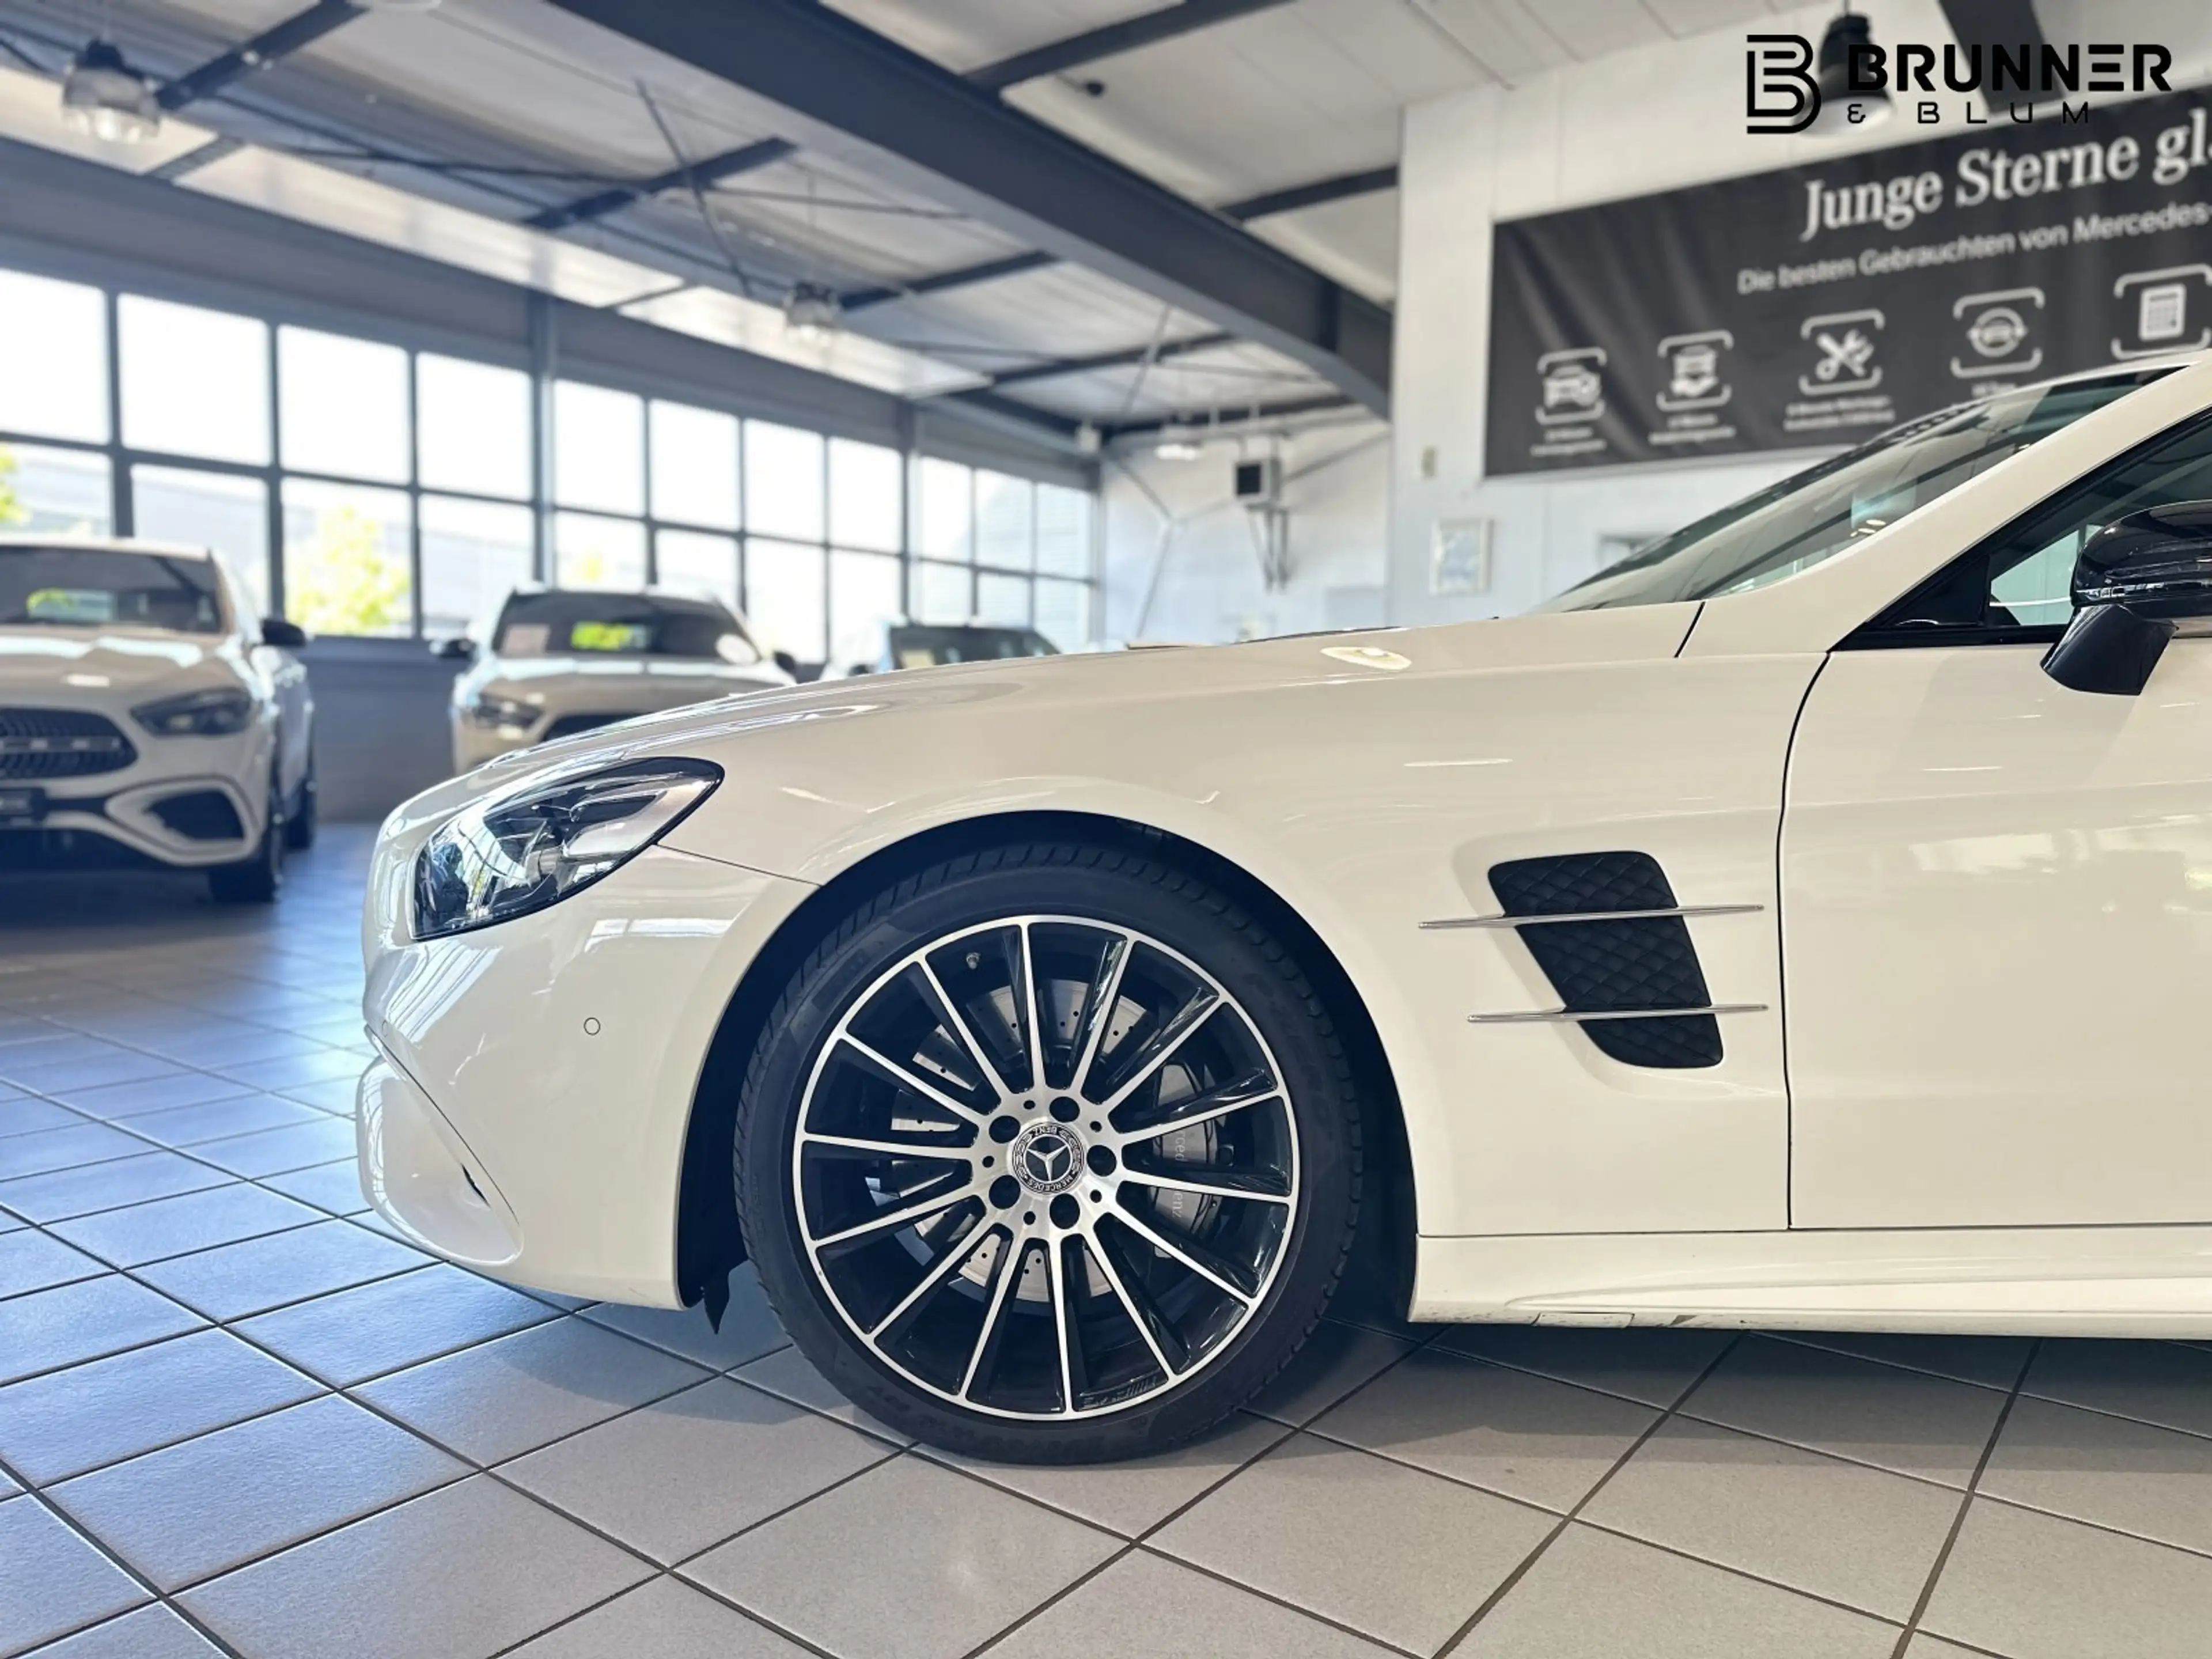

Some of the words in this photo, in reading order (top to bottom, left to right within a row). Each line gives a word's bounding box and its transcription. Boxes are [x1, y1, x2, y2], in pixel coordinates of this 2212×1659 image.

[1799, 172, 1943, 243] Junge
[1955, 135, 2140, 208] Sterne
[2152, 107, 2212, 186] gl
[1737, 267, 1776, 295] Die
[1778, 257, 1857, 289] besten
[1859, 232, 2016, 276] Gebrauchten
[2018, 224, 2069, 252] von
